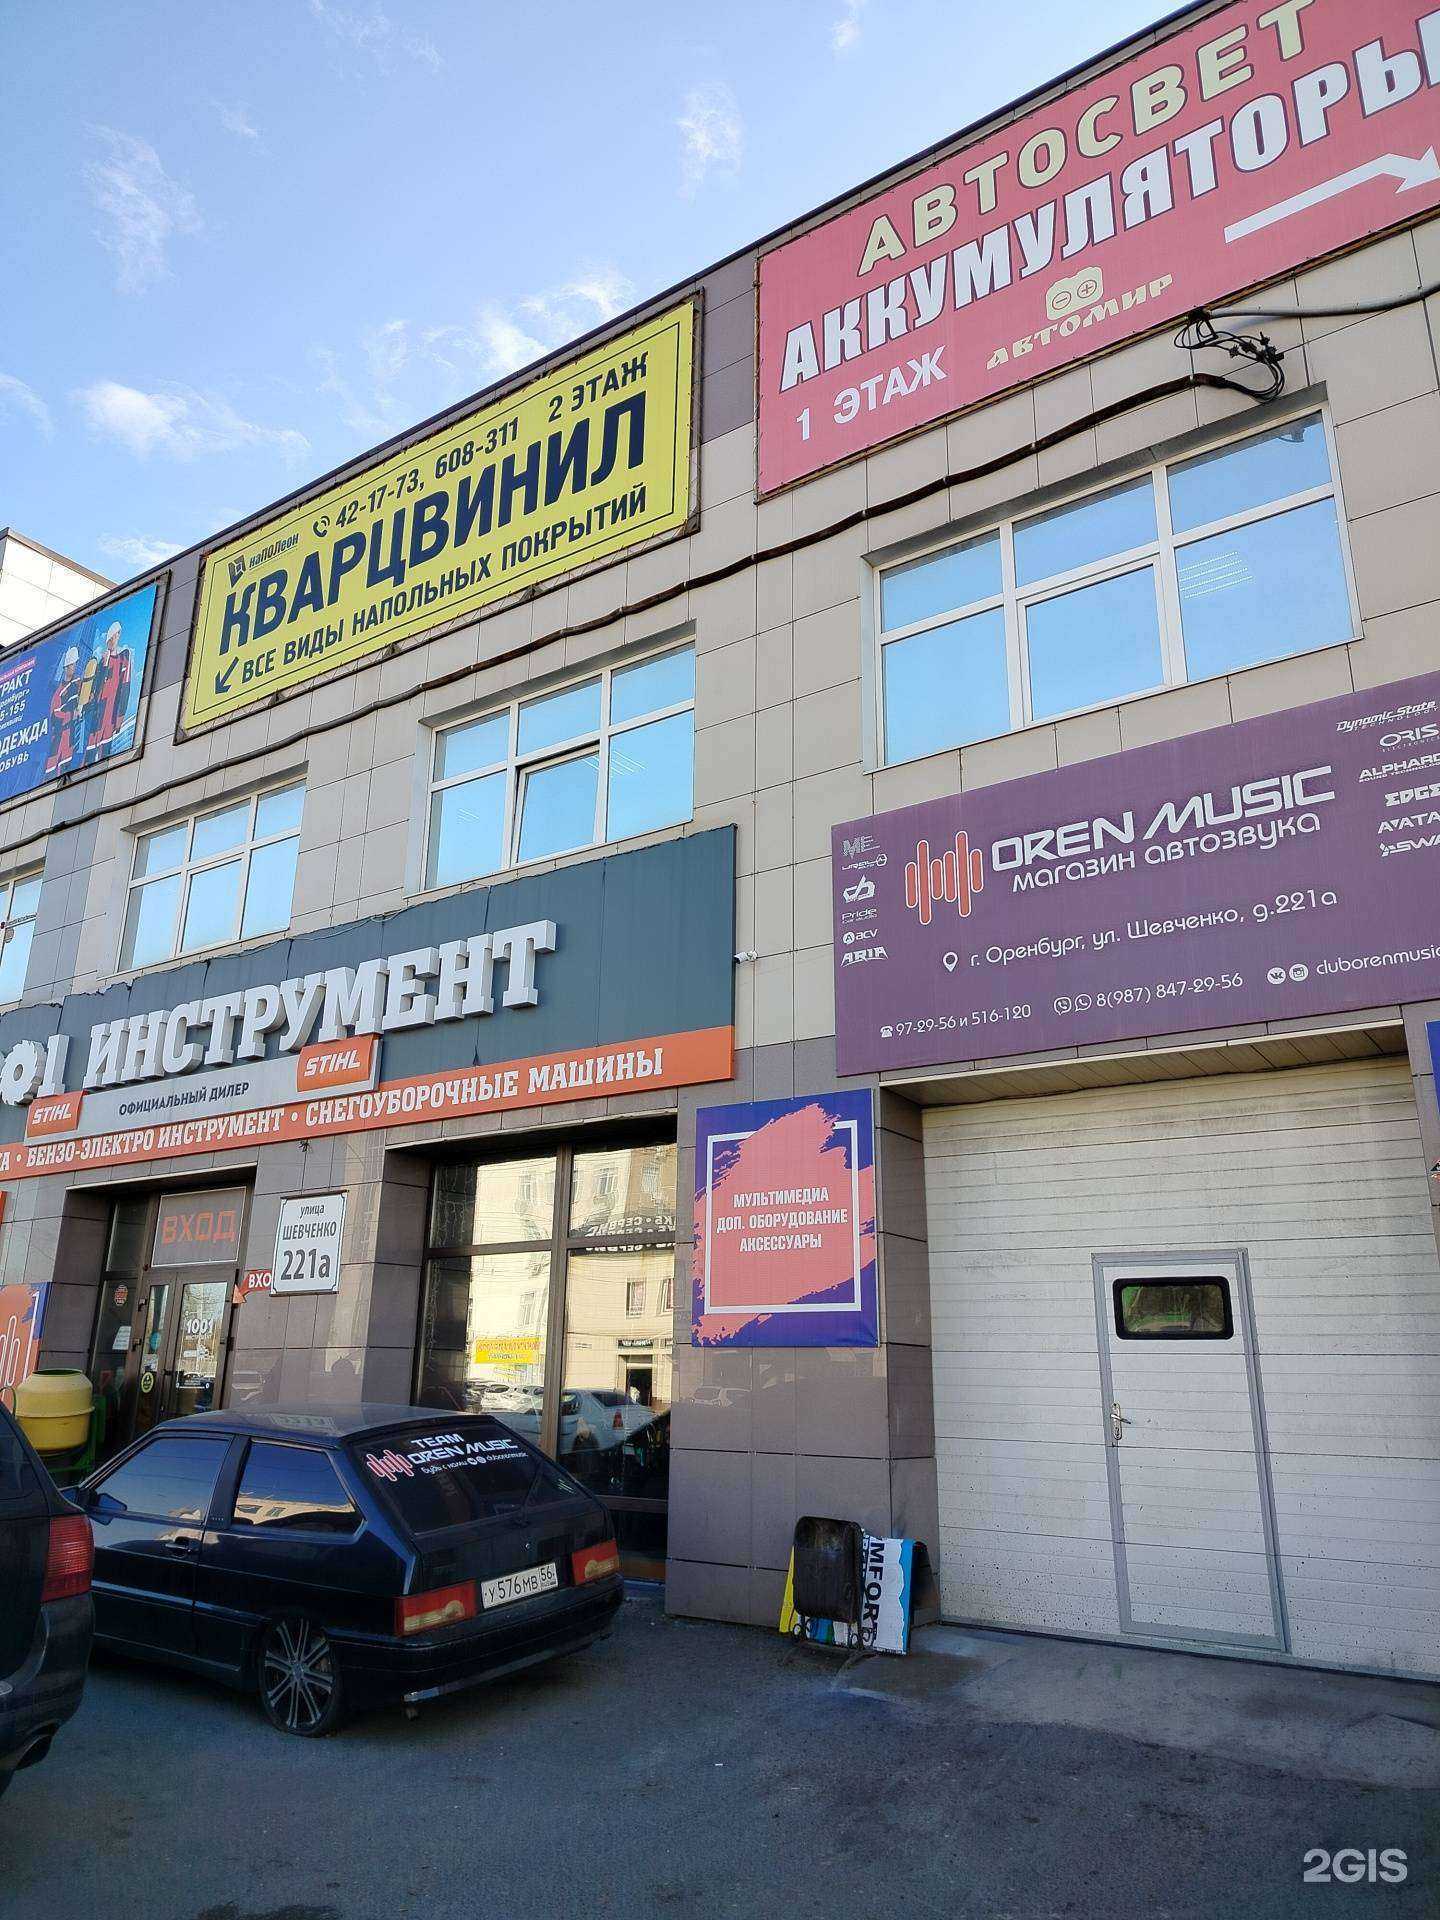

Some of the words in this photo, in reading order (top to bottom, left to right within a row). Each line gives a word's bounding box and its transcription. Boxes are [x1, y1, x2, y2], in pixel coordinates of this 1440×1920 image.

[857, 0, 1315, 278] АВТОСВЕТ
[778, 9, 1440, 394] АККУМУЛЯТОРЫ
[986, 274, 1174, 370] АВТОМИР
[795, 405, 812, 441] 1
[833, 344, 950, 426] ЭТАЖ
[335, 468, 426, 529] 42-17-73,
[435, 416, 519, 480] 608-311
[548, 395, 564, 424] 2
[570, 350, 649, 413] ЭТАЖ
[218, 390, 647, 657] КВАРЦВИНИЛ
[241, 648, 277, 685] ВСЕ
[283, 623, 344, 667] ВИДЫ
[351, 557, 492, 636] НАПОЛЬНЫХ
[501, 482, 647, 571] ПОКРЫТИЙ
[0, 668, 33, 698] РАКТ
[1379, 723, 1440, 747] ORIS
[991, 809, 1136, 873] OREN
[1143, 765, 1336, 840] MUSIC
[1012, 850, 1137, 893] магазин
[1143, 811, 1321, 867] автозвука
[986, 931, 1085, 968] Оренбург,
[1092, 927, 1121, 951] ул.
[1127, 906, 1245, 941] Шевченко,
[82, 919, 558, 1091] ИНСТРУМЕНТ
[1097, 985, 1151, 1009] 8(987)
[1156, 972, 1244, 1000] 847-29-56
[895, 1014, 957, 1037] 97-29-56
[971, 1004, 1032, 1026] 516-120
[303, 1049, 362, 1078] STIHL
[27, 1129, 155, 1168] БЕНЗО-ЭЛЕКТРО
[158, 1108, 285, 1149] ИНСТРУМЕНТ
[305, 1068, 519, 1127] СНЕГОУБОРОЧНЫЕ
[528, 1047, 664, 1091] МАШИНЫ
[31, 1102, 73, 1126] STIHL
[118, 1086, 207, 1117] ОФИЦИАЛЬНЫЙ
[209, 1082, 250, 1104] ДИЛЕР
[299, 1204, 325, 1219] улица
[733, 1186, 830, 1209] МУЛЬТИМЕДИА
[162, 1209, 237, 1245] ВХОД
[282, 1220, 337, 1241] ШЕВЧЕНКО
[716, 1214, 746, 1234] ДОП.
[749, 1208, 849, 1230] ОБОРУДОВАНИЕ
[739, 1233, 823, 1253] АКСЕССУАРЫ
[407, 1445, 465, 1465] OREN
[465, 1439, 519, 1454] MUSIC
[411, 1433, 465, 1449] TEAM
